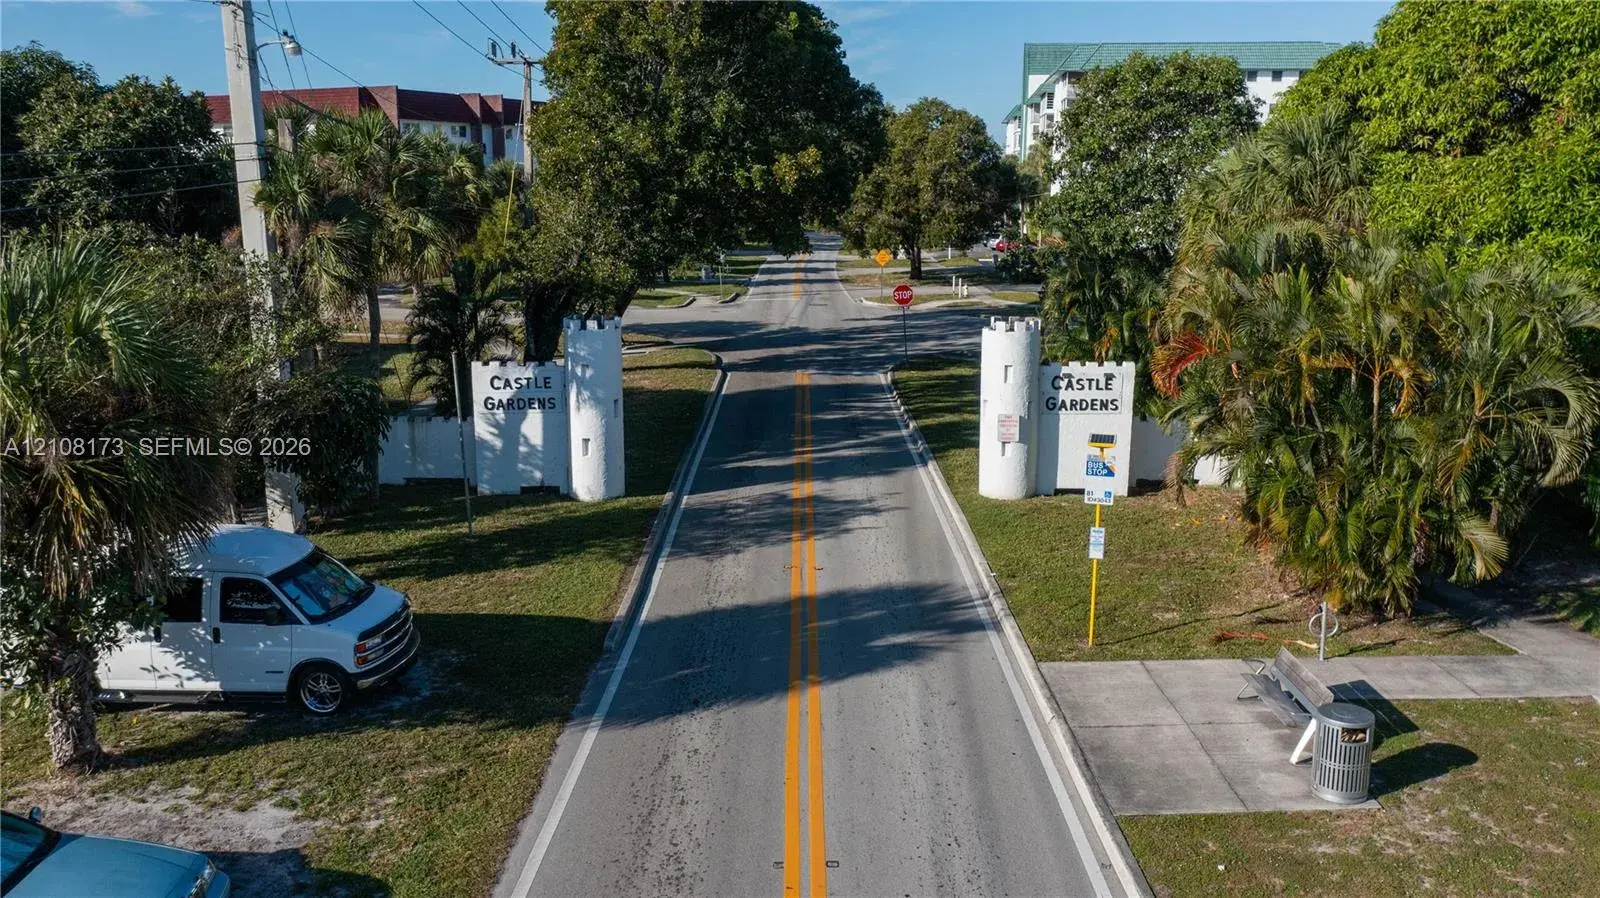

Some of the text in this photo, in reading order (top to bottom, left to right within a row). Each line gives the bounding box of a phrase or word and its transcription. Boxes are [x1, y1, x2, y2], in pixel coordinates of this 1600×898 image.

[894, 290, 912, 300] STOP
[490, 375, 552, 390] CASTLE
[1052, 375, 1113, 391] CASTLE
[483, 396, 556, 411] GARDENS
[1045, 396, 1119, 412] GARDENS
